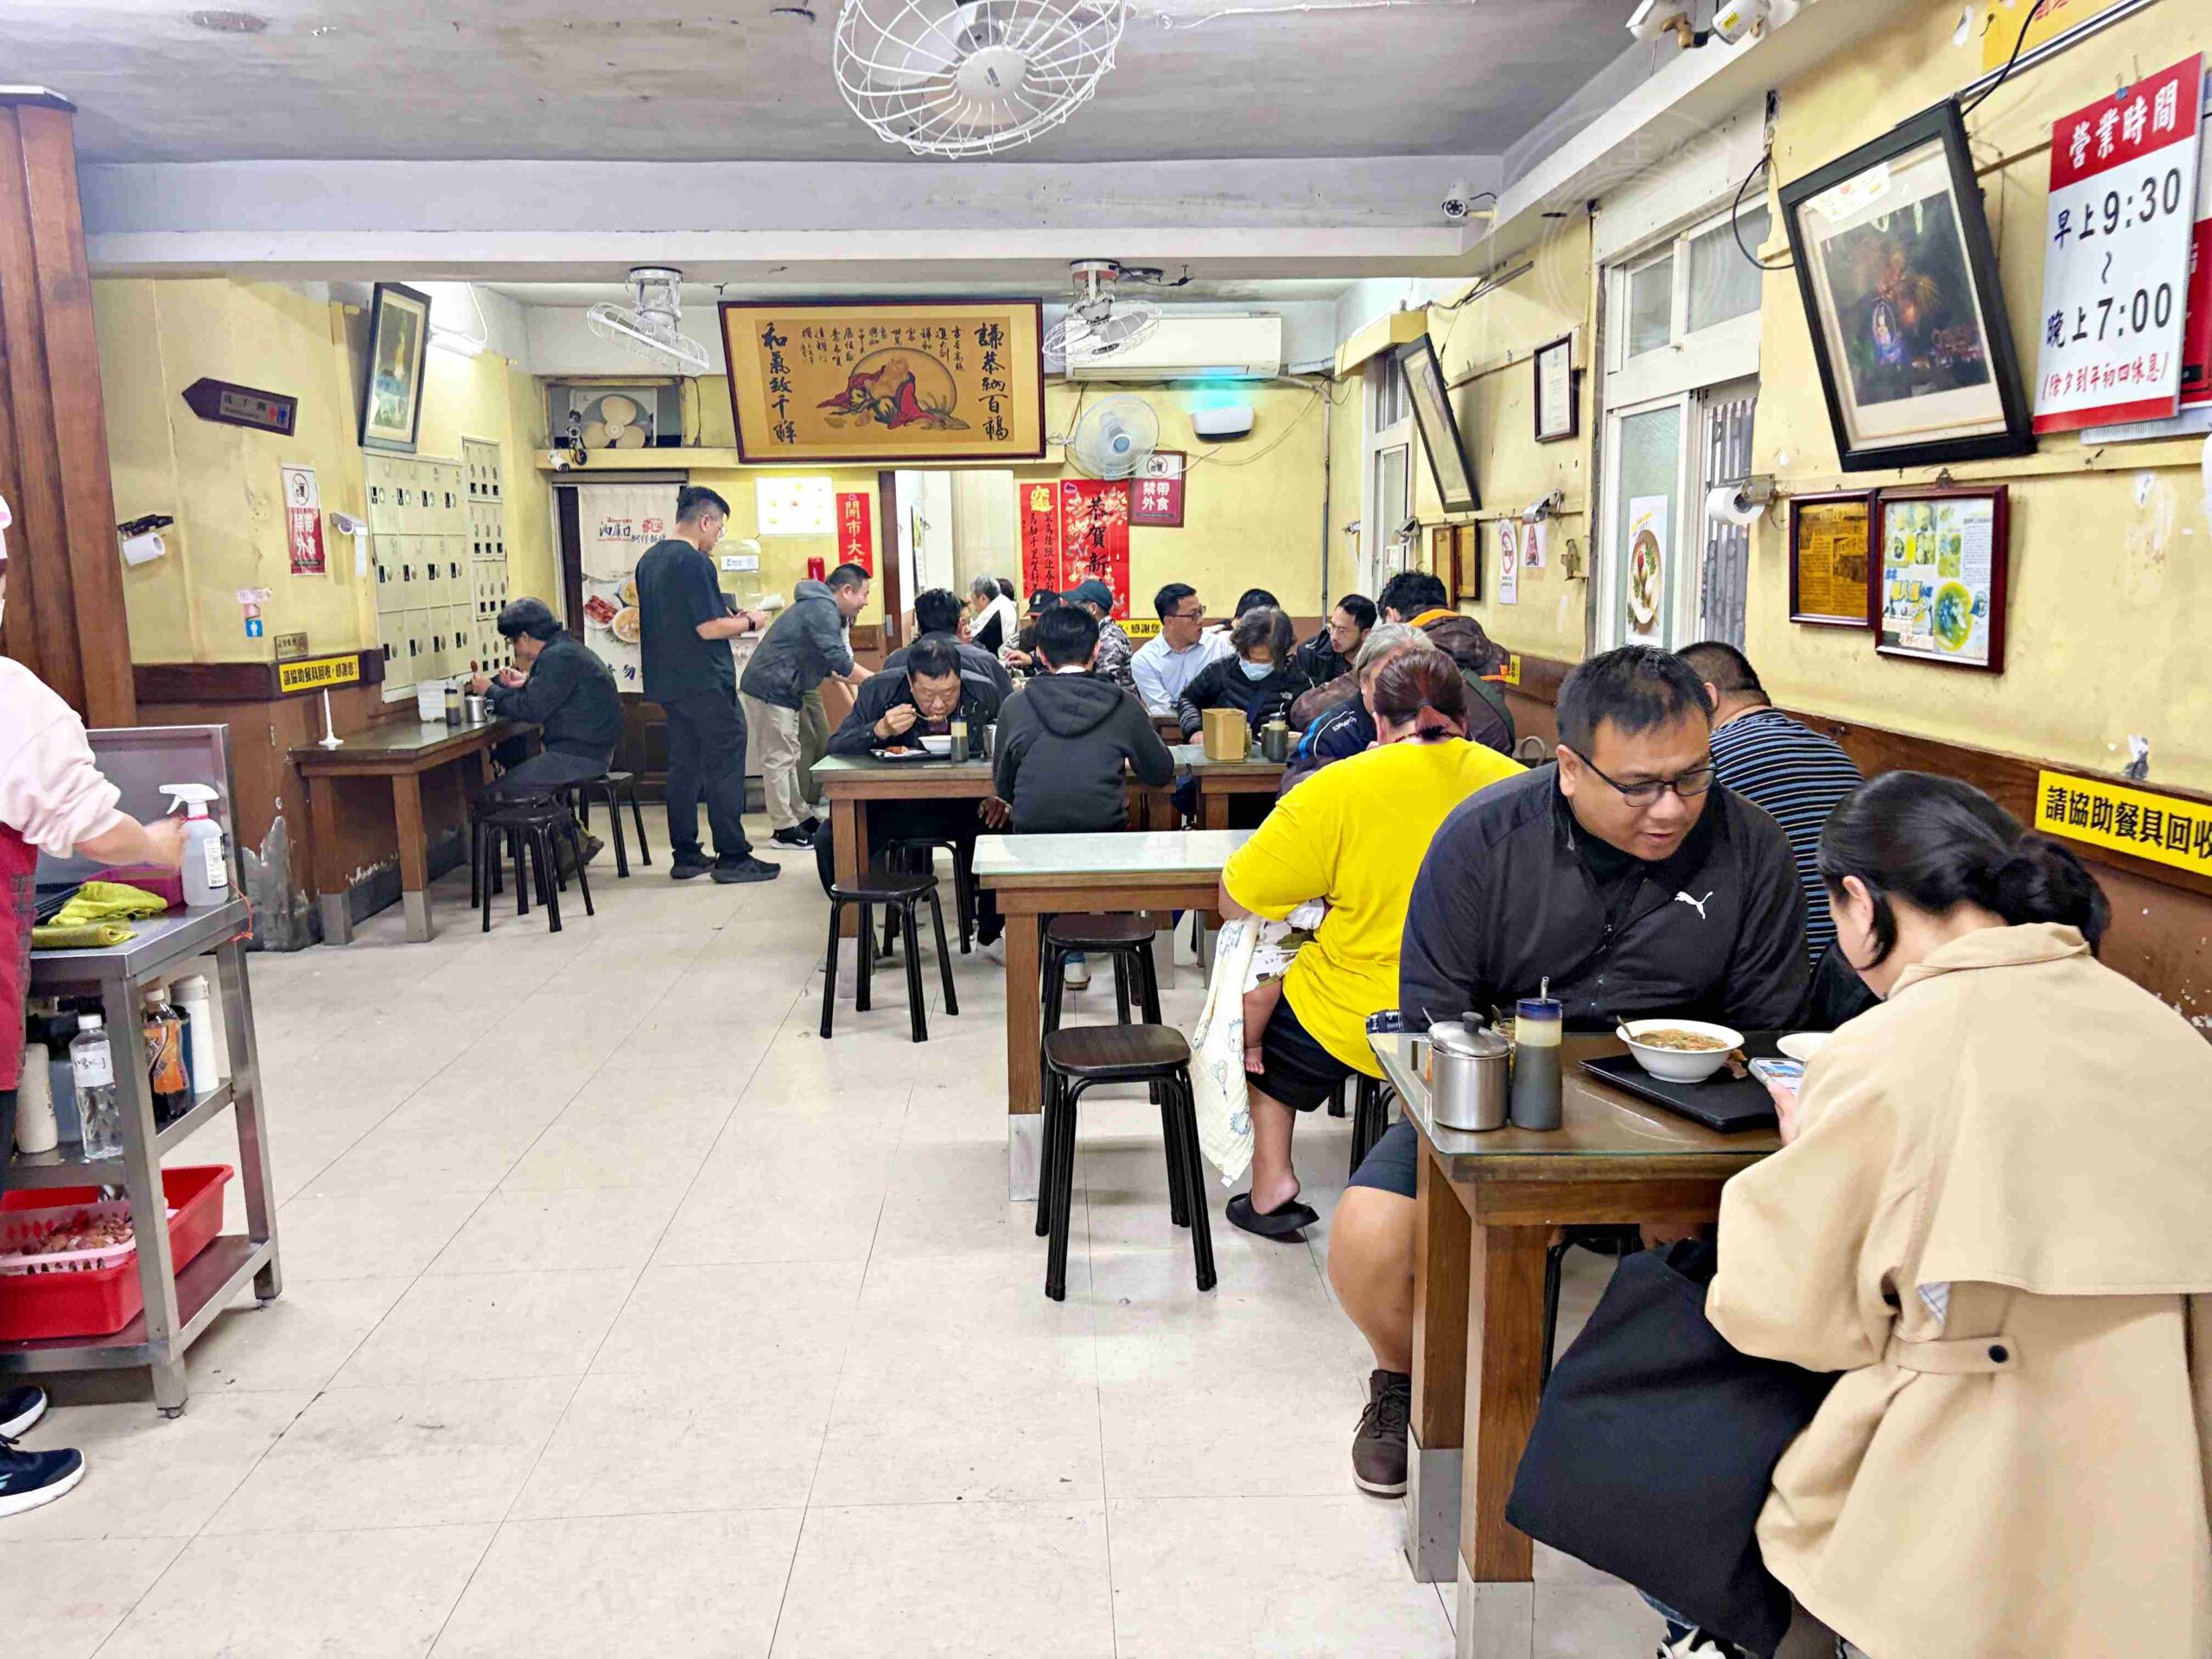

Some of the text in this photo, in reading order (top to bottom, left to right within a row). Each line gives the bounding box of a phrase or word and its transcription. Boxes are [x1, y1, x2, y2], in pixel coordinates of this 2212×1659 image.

[2069, 78, 2179, 169] 營業時間
[2053, 168, 2181, 250] 早上9:30
[2046, 282, 2171, 348] 晚上7:00
[1141, 495, 1170, 512] 外食
[1142, 480, 1171, 496] 禁帶
[1085, 495, 1111, 582] 恭賀新
